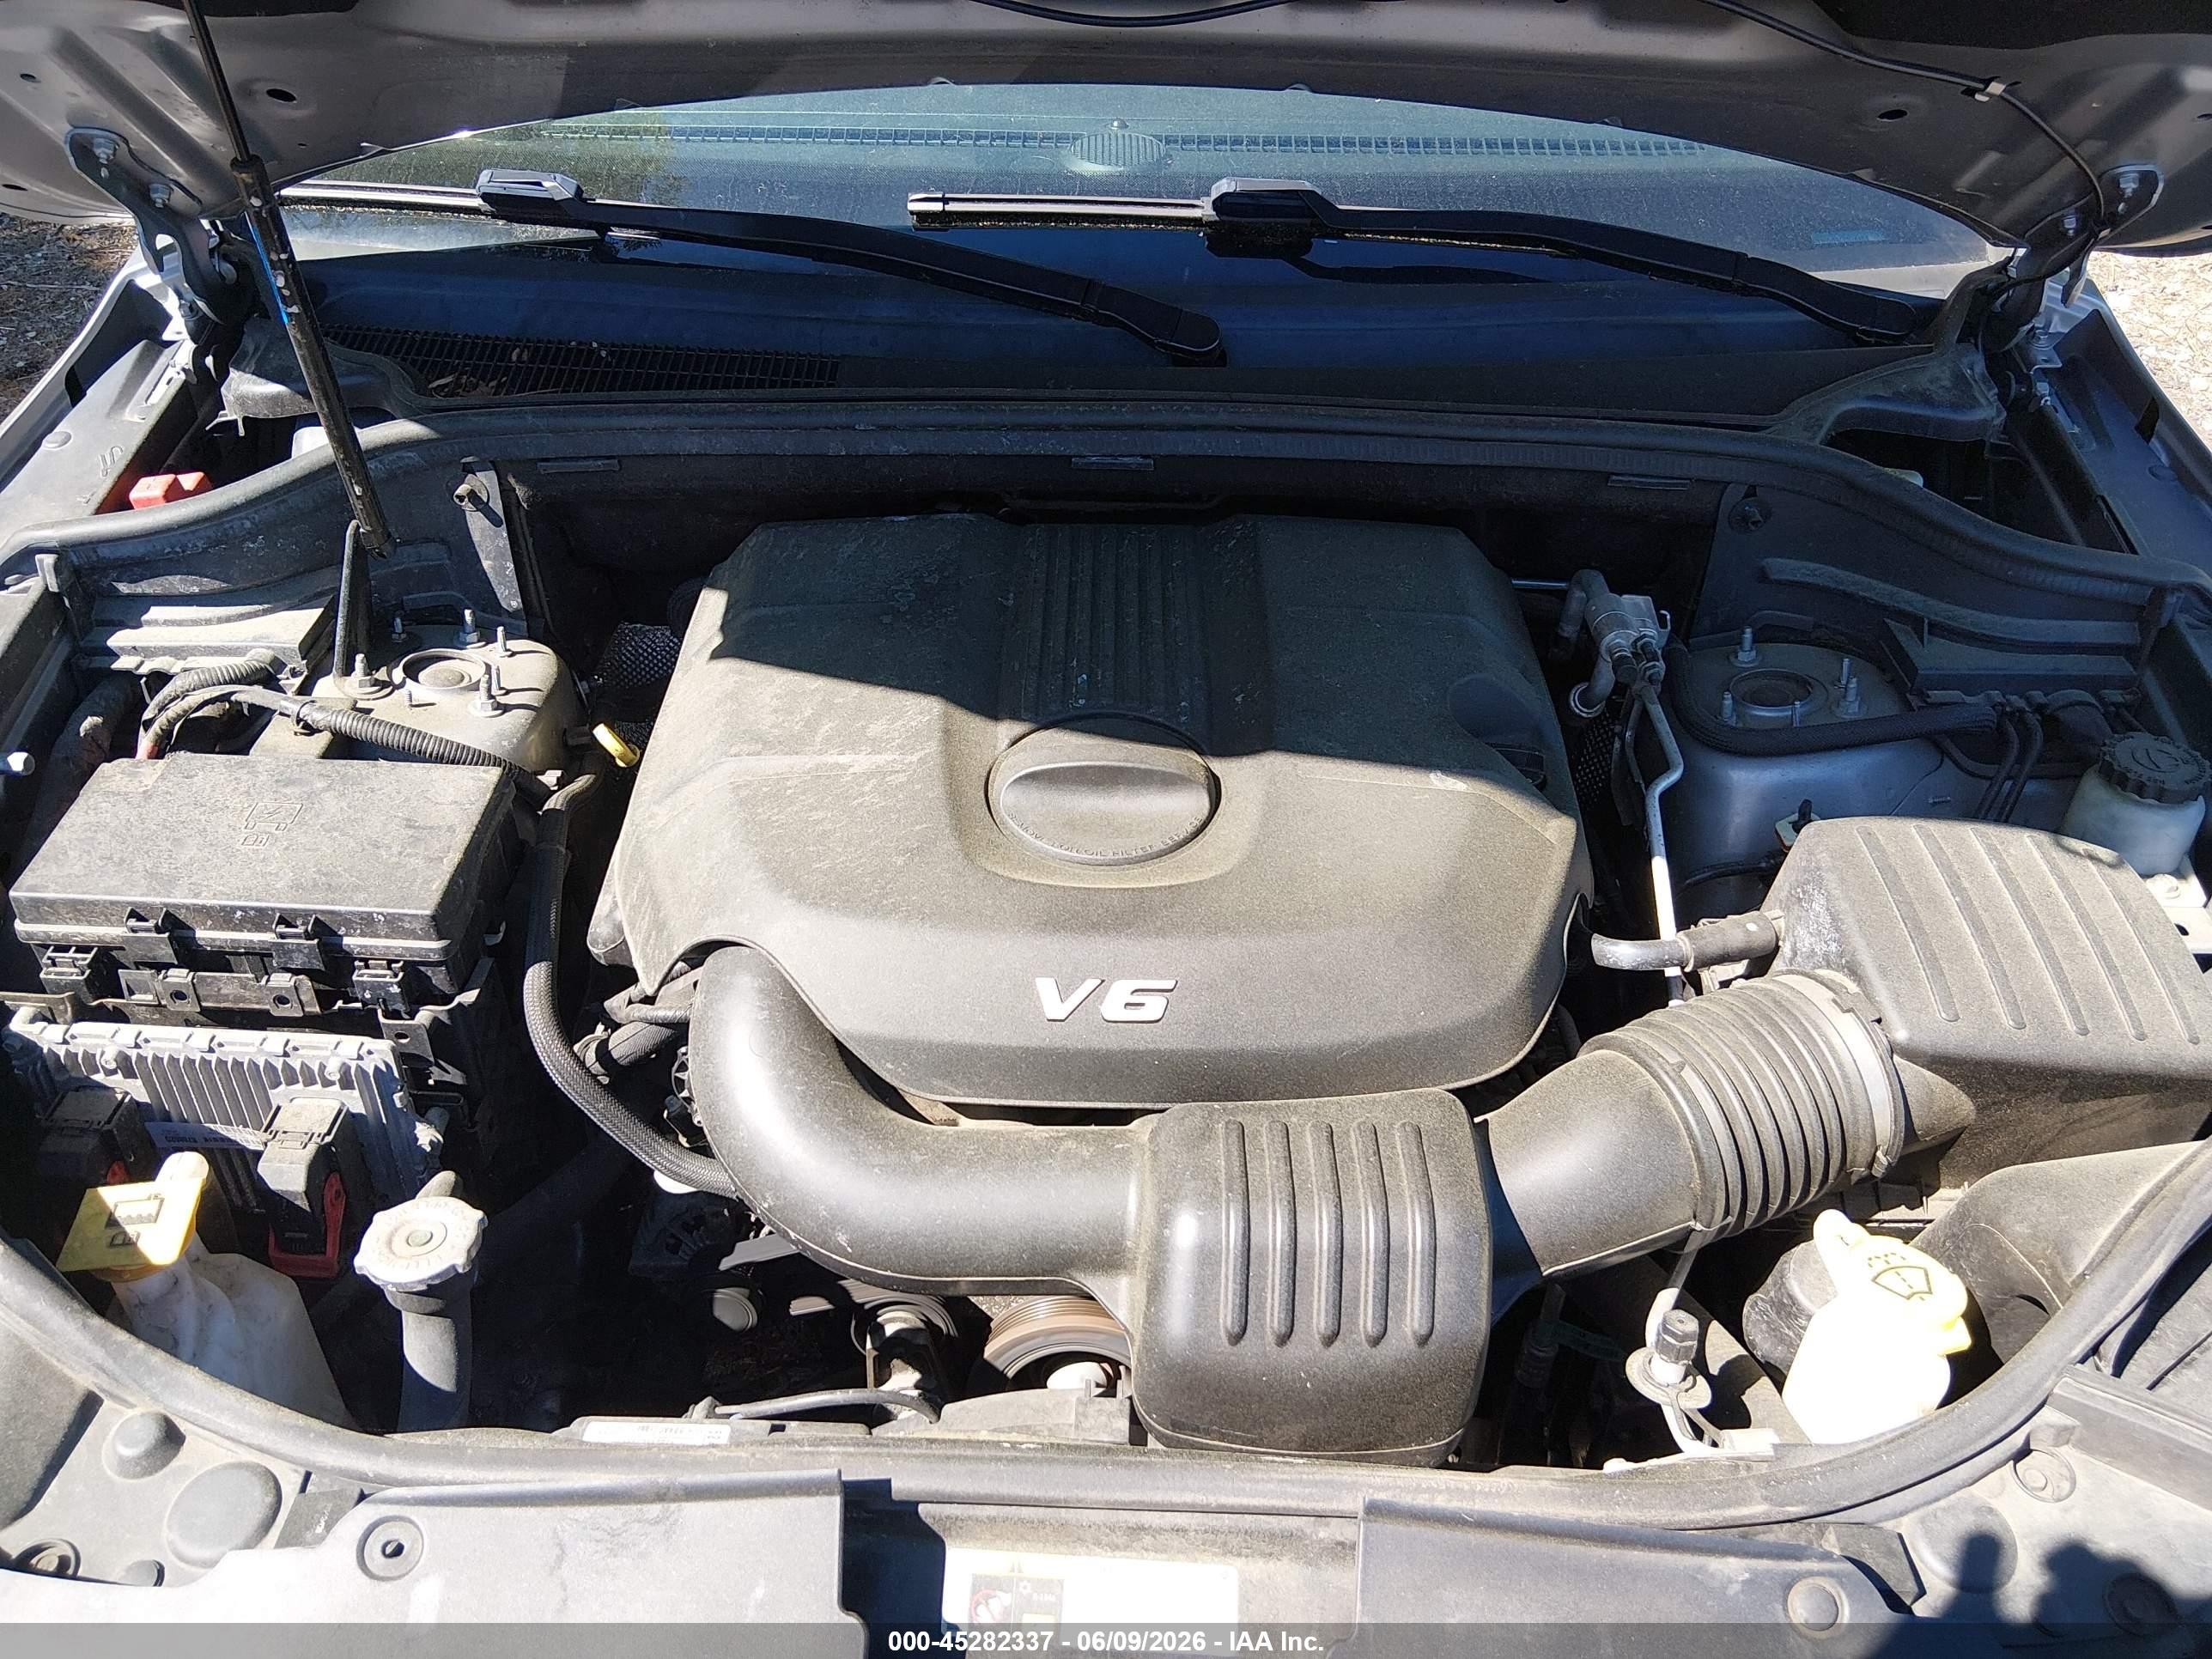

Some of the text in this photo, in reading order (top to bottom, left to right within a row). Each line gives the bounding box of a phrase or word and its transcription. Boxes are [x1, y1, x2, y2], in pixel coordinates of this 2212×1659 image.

[1083, 848, 1106, 857] OIL
[1112, 843, 1156, 857] FILTER
[1035, 977, 1178, 1023] V6
